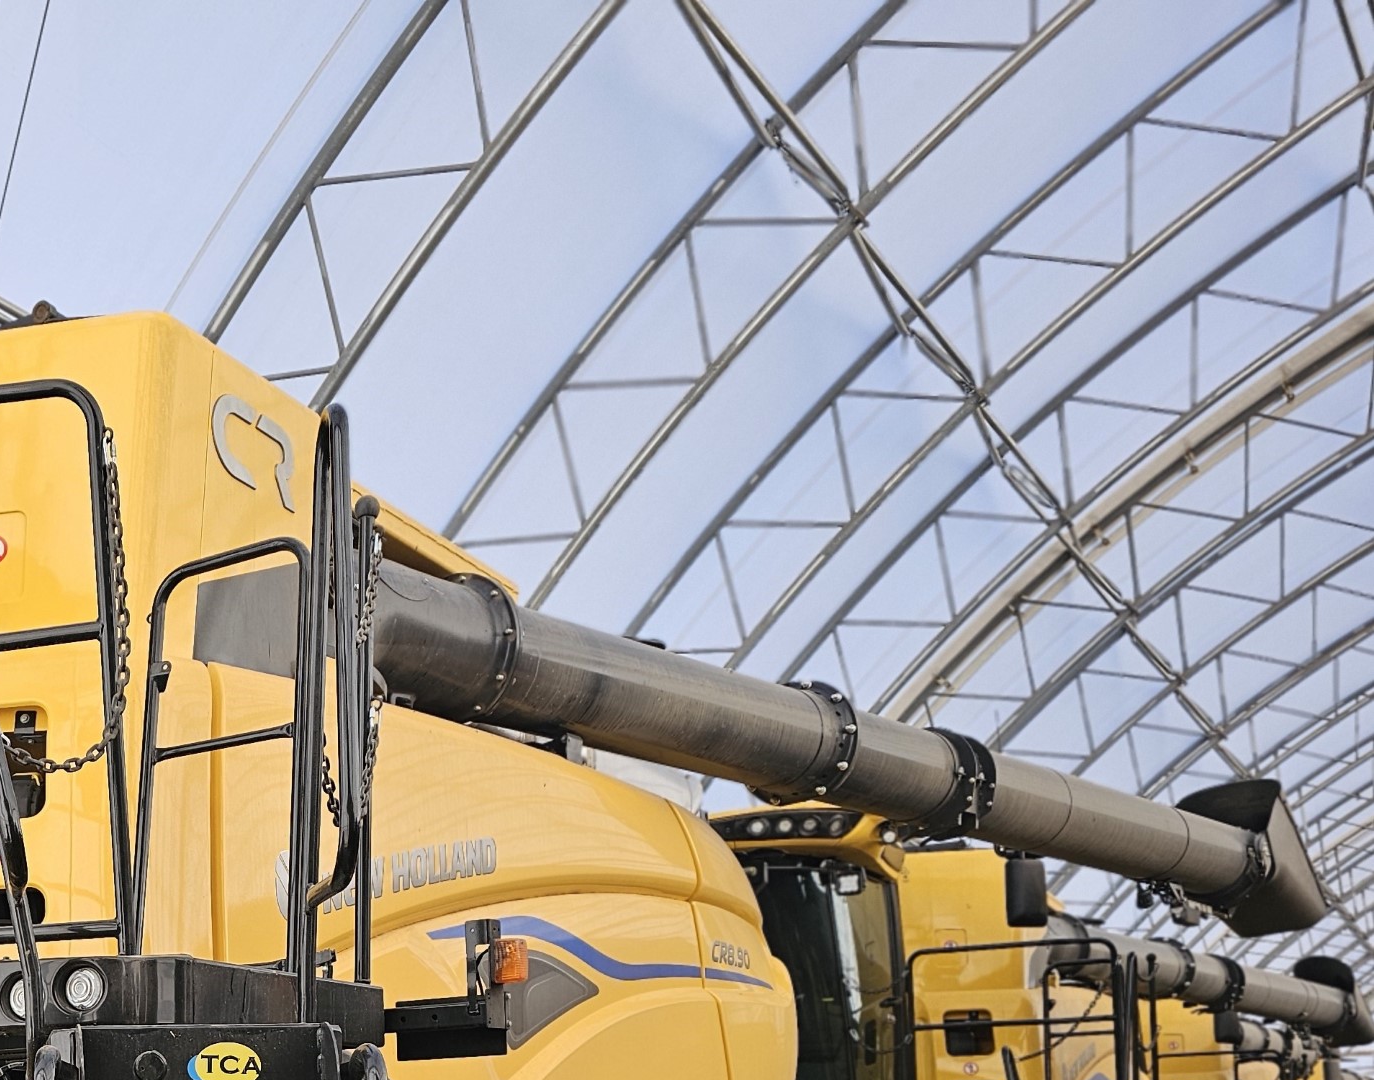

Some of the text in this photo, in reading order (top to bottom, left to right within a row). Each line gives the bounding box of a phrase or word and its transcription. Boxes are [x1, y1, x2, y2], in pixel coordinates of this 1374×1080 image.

[391, 836, 497, 894] HOLLAND
[711, 940, 751, 970] CR8.90
[200, 1053, 261, 1075] TCA
